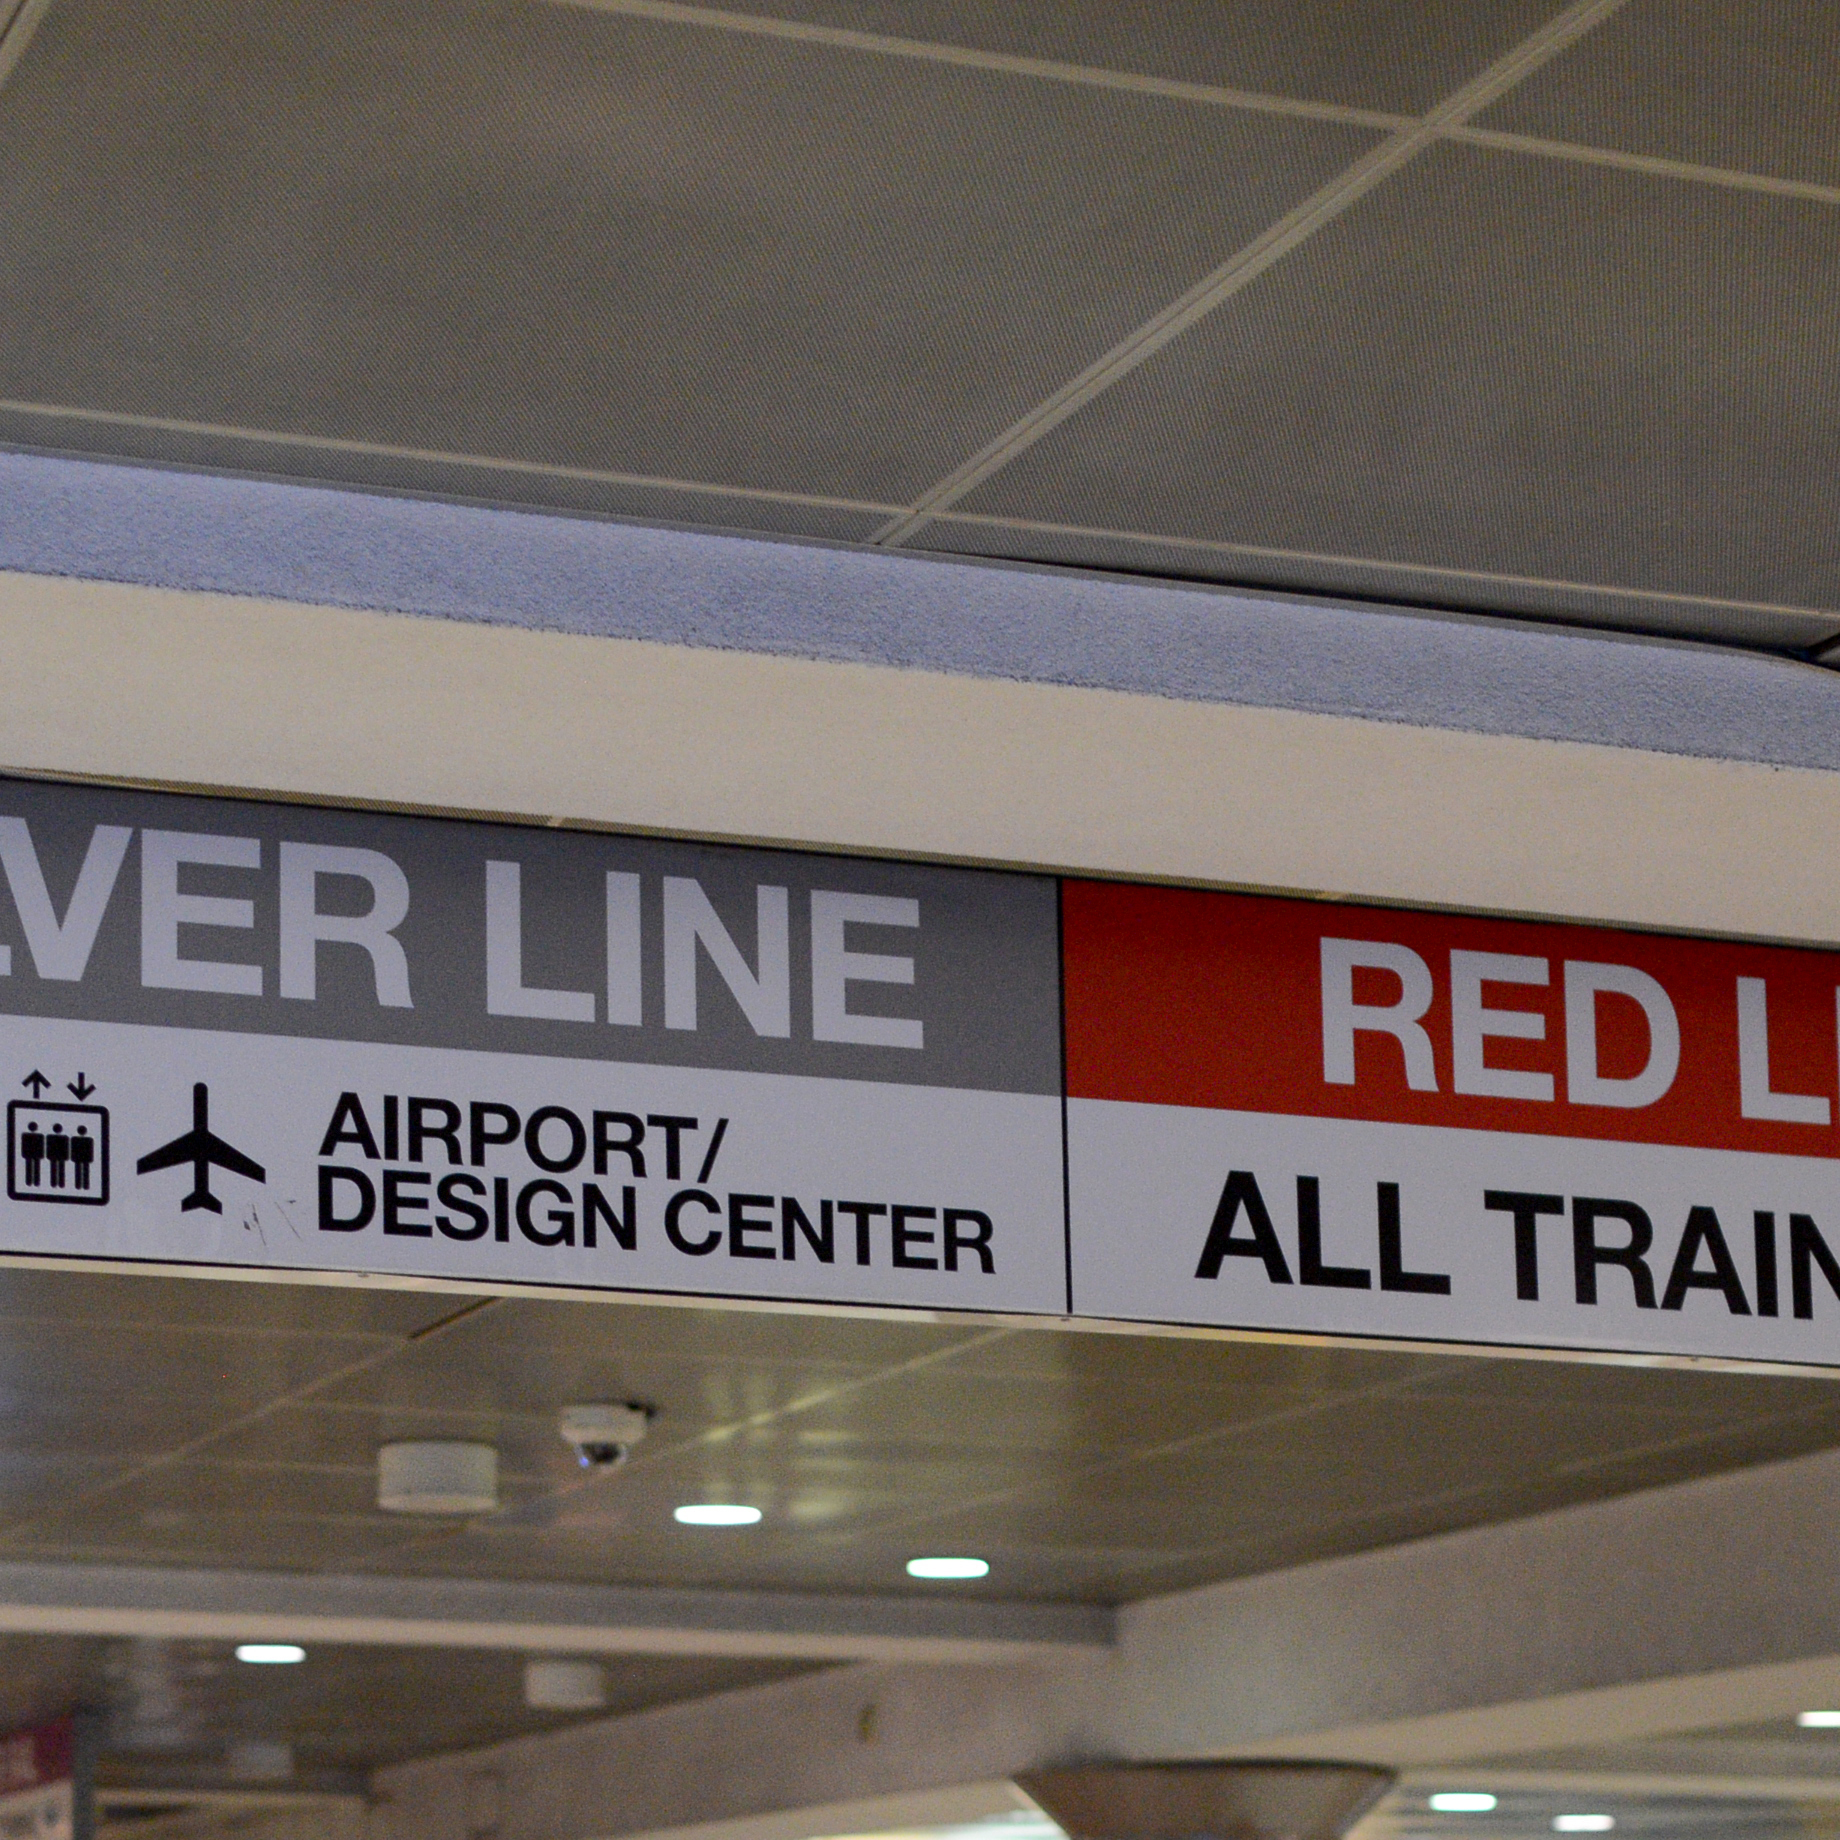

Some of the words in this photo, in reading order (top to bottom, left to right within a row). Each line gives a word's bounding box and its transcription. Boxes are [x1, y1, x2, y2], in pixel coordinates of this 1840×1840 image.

[485, 859, 924, 1050] LINE
[1320, 936, 1681, 1108] RED
[318, 1092, 728, 1186] AIRPORT/
[317, 1169, 639, 1252] DESIGN
[663, 1194, 996, 1276] CENTER
[1194, 1170, 1452, 1295] ALL
